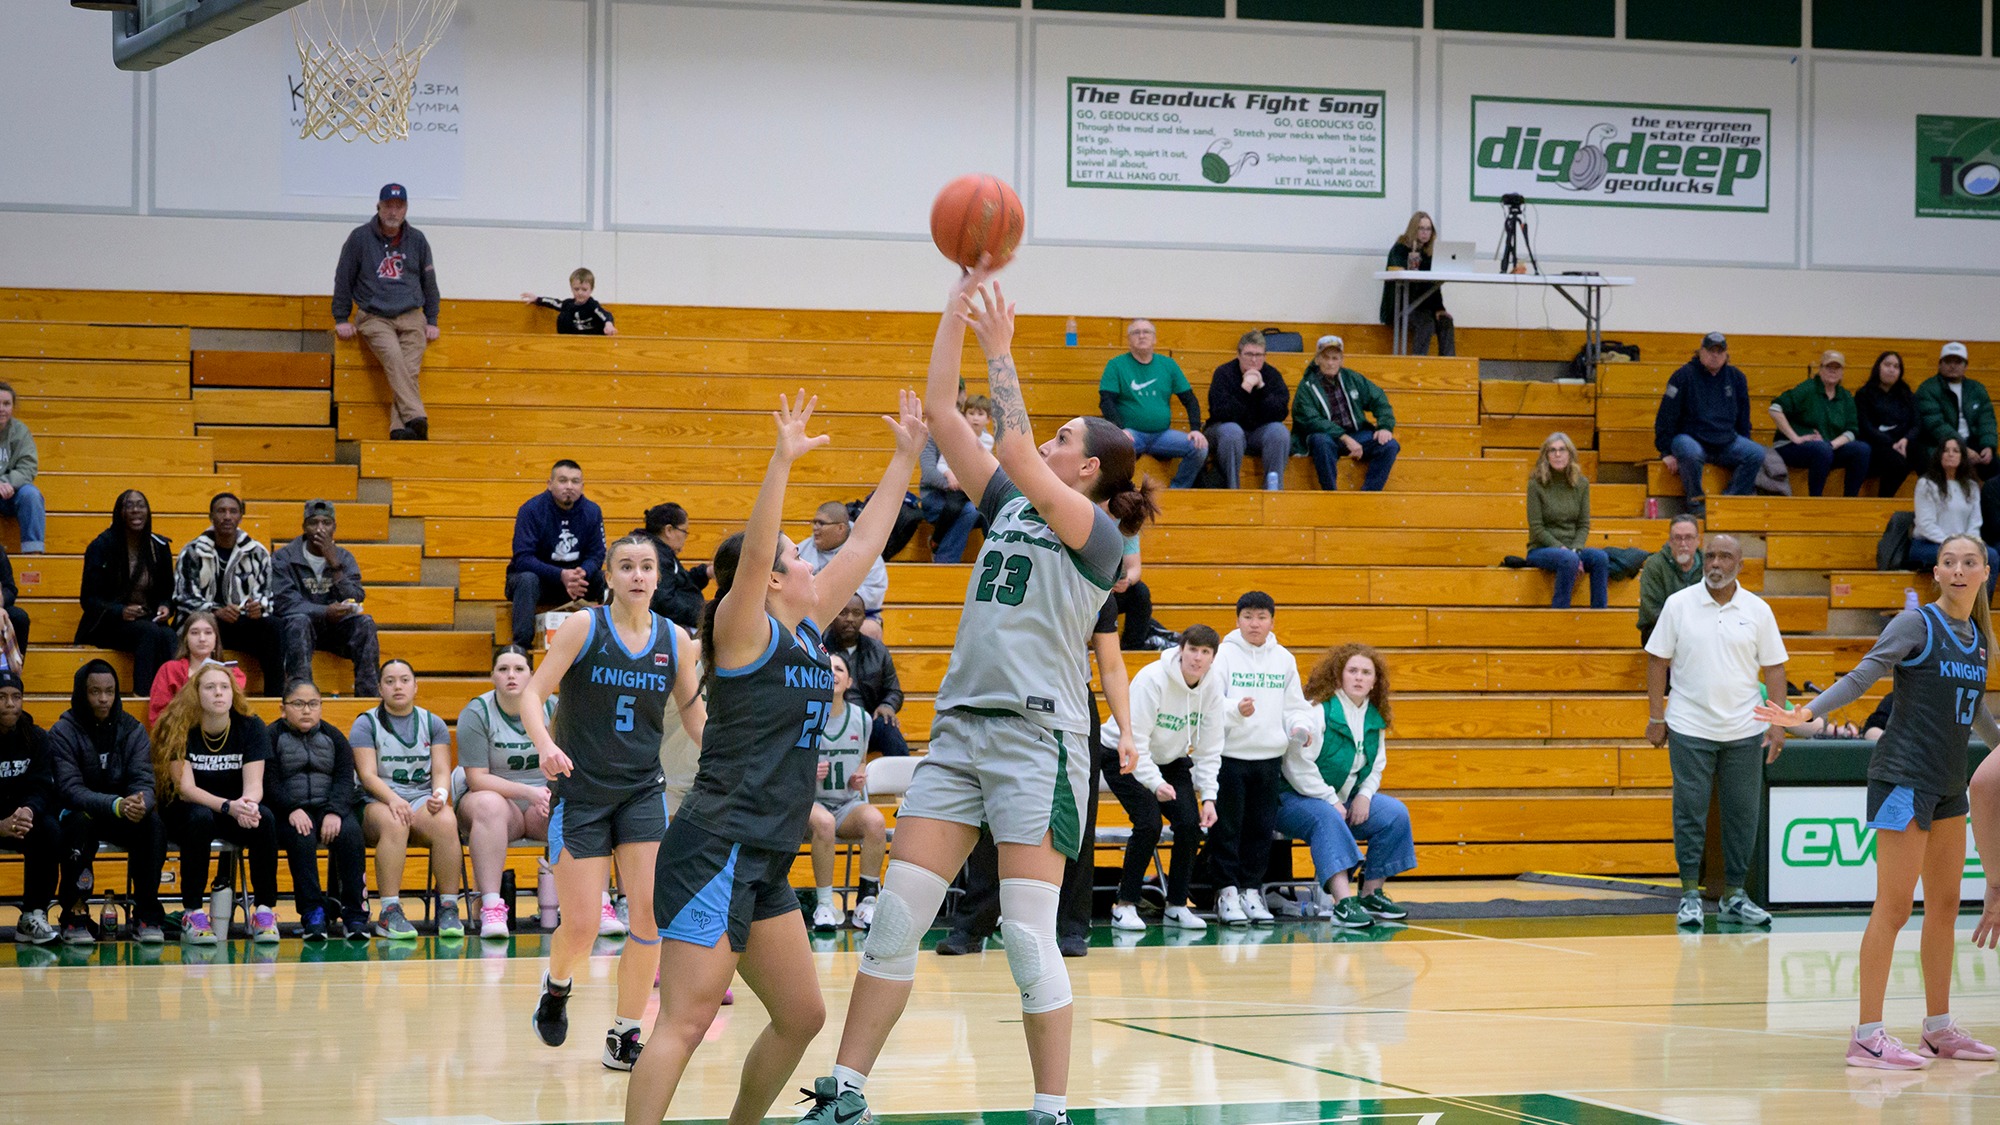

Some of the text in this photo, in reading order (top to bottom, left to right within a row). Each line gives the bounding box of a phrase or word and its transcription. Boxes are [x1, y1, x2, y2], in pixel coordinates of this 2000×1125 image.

[1076, 87, 1379, 119] The Geoduck Fight Song
[1077, 109, 1182, 123] GO, GEODUCKS GO,
[1077, 122, 1216, 137] Through the mud and the sand,
[1296, 119, 1354, 130] GEODUCKS
[1357, 121, 1376, 131] GO,
[1632, 116, 1752, 134] the evergreen
[1076, 134, 1095, 143] let's
[1233, 128, 1376, 142] Stretch your necks when the tide
[1649, 130, 1761, 148] state college
[1076, 146, 1107, 157] Siphon
[1134, 149, 1159, 160] squirt
[1162, 149, 1168, 157] it
[1349, 145, 1356, 153] is
[1076, 159, 1104, 167] swivel
[1107, 160, 1118, 168] all
[1267, 153, 1297, 164] Siphon
[1323, 156, 1348, 167] squirt
[1350, 156, 1356, 165] it
[1477, 126, 1762, 197] dig deep
[1076, 170, 1093, 178] LET
[1095, 170, 1104, 179] IT
[1107, 171, 1124, 179] ALL
[1127, 172, 1156, 180] HANG
[1307, 167, 1334, 175] swivel
[1336, 168, 1346, 176] all
[1275, 177, 1292, 185] LET
[1293, 177, 1302, 186] IT
[1304, 178, 1321, 187] ALL
[1324, 179, 1353, 187] HANG
[1604, 176, 1714, 195] geoducks
[976, 550, 1033, 607] 23
[591, 665, 667, 692] KNIGHTS
[784, 665, 834, 690] KNIGH
[1940, 661, 1987, 682] KNIGHT
[615, 694, 638, 733] 5
[1955, 687, 1979, 725] 13
